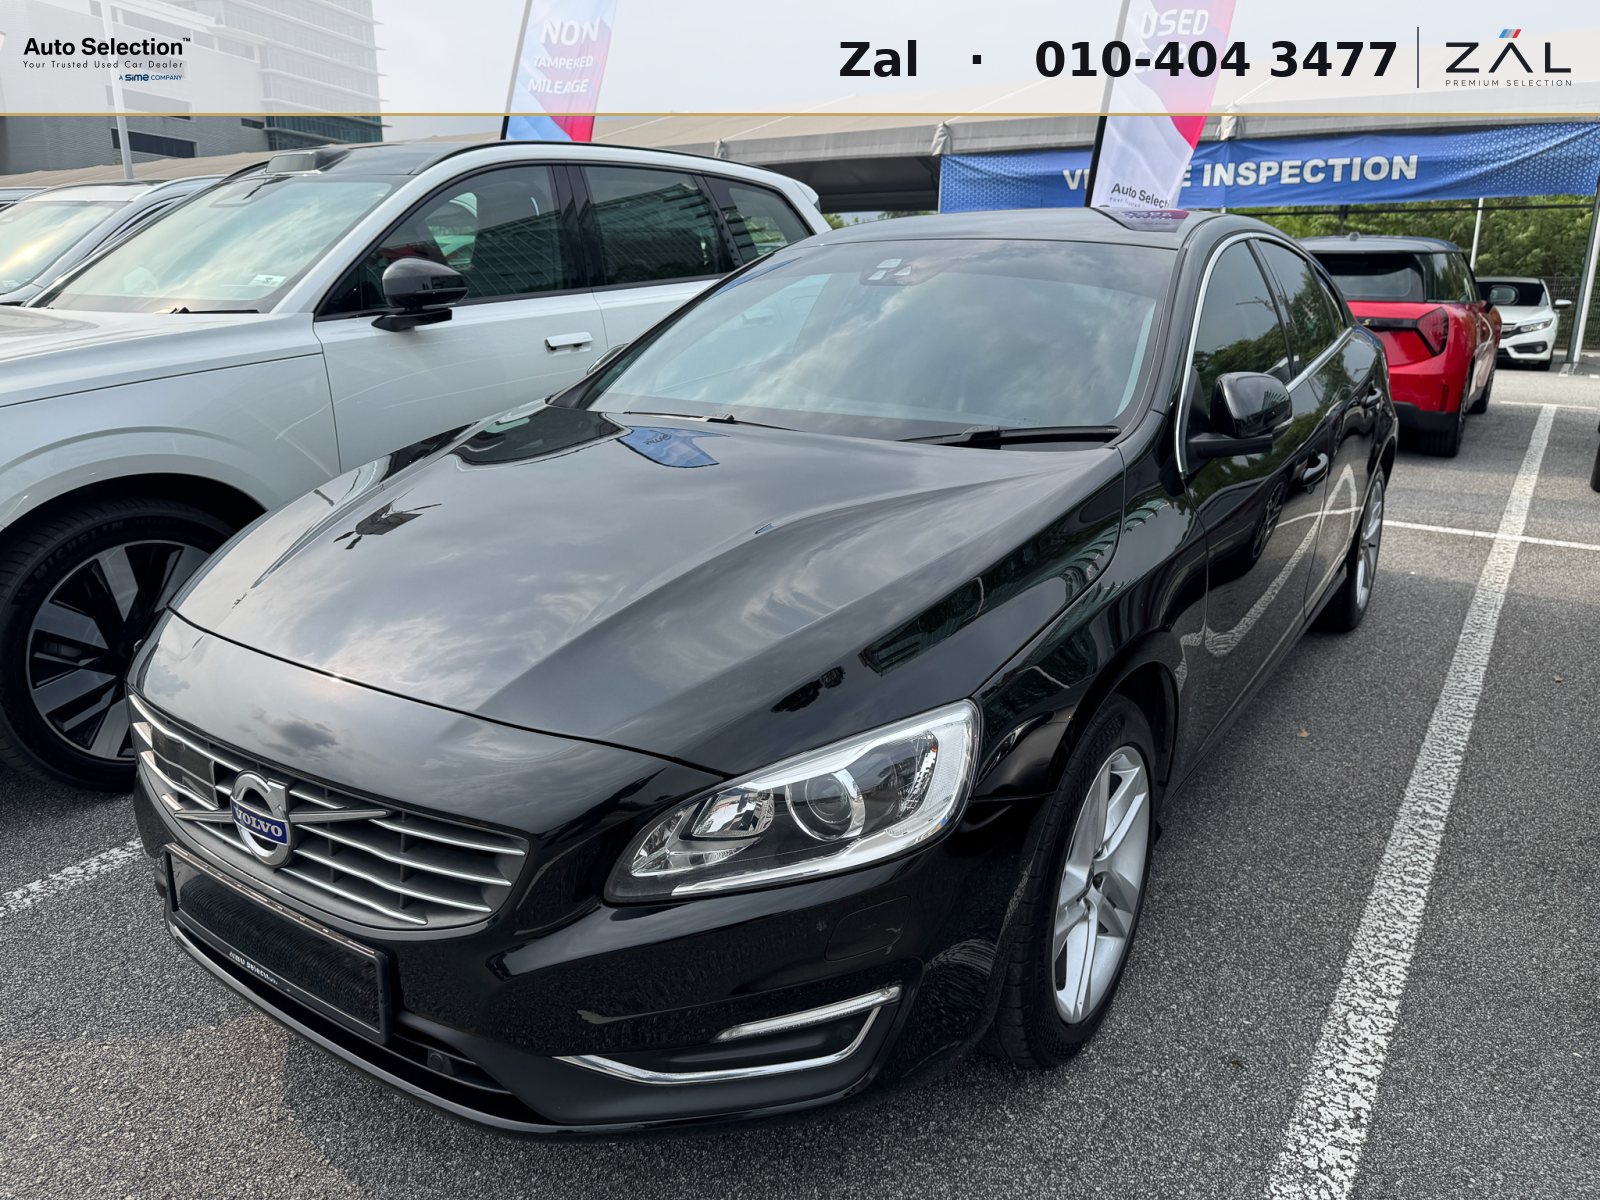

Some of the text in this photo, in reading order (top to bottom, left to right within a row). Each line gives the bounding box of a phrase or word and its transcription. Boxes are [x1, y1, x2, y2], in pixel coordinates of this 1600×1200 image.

[540, 16, 601, 46] NON
[1141, 9, 1209, 39] USED
[534, 55, 594, 70] TAMPERED
[528, 78, 589, 94] MILEAGE
[1202, 155, 1418, 187] INSPECTION
[1111, 183, 1137, 199] Auto
[233, 804, 283, 837] VOLVO
